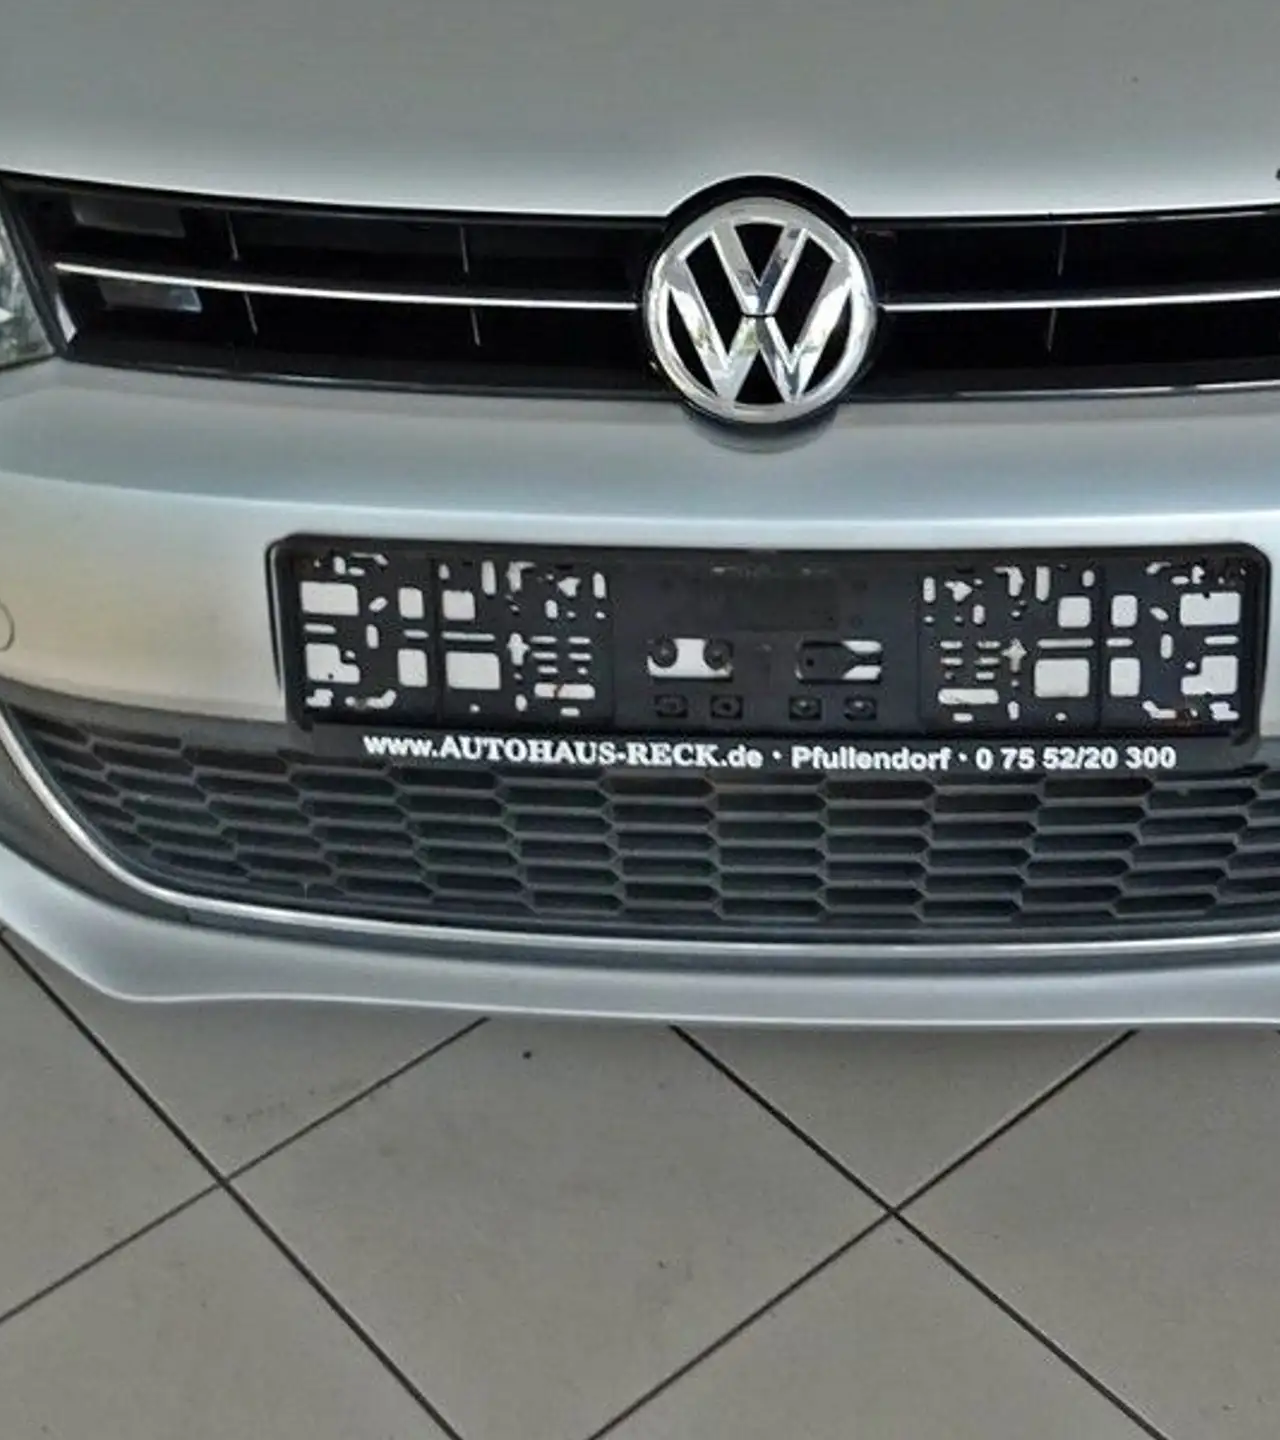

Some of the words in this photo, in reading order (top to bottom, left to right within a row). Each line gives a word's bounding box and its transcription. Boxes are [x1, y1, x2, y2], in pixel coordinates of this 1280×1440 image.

[656, 208, 865, 414] VW
[362, 734, 763, 768] www.AUTOHAUS-RECK.de
[790, 745, 951, 770] Pfullendorf
[1124, 745, 1177, 770] 300
